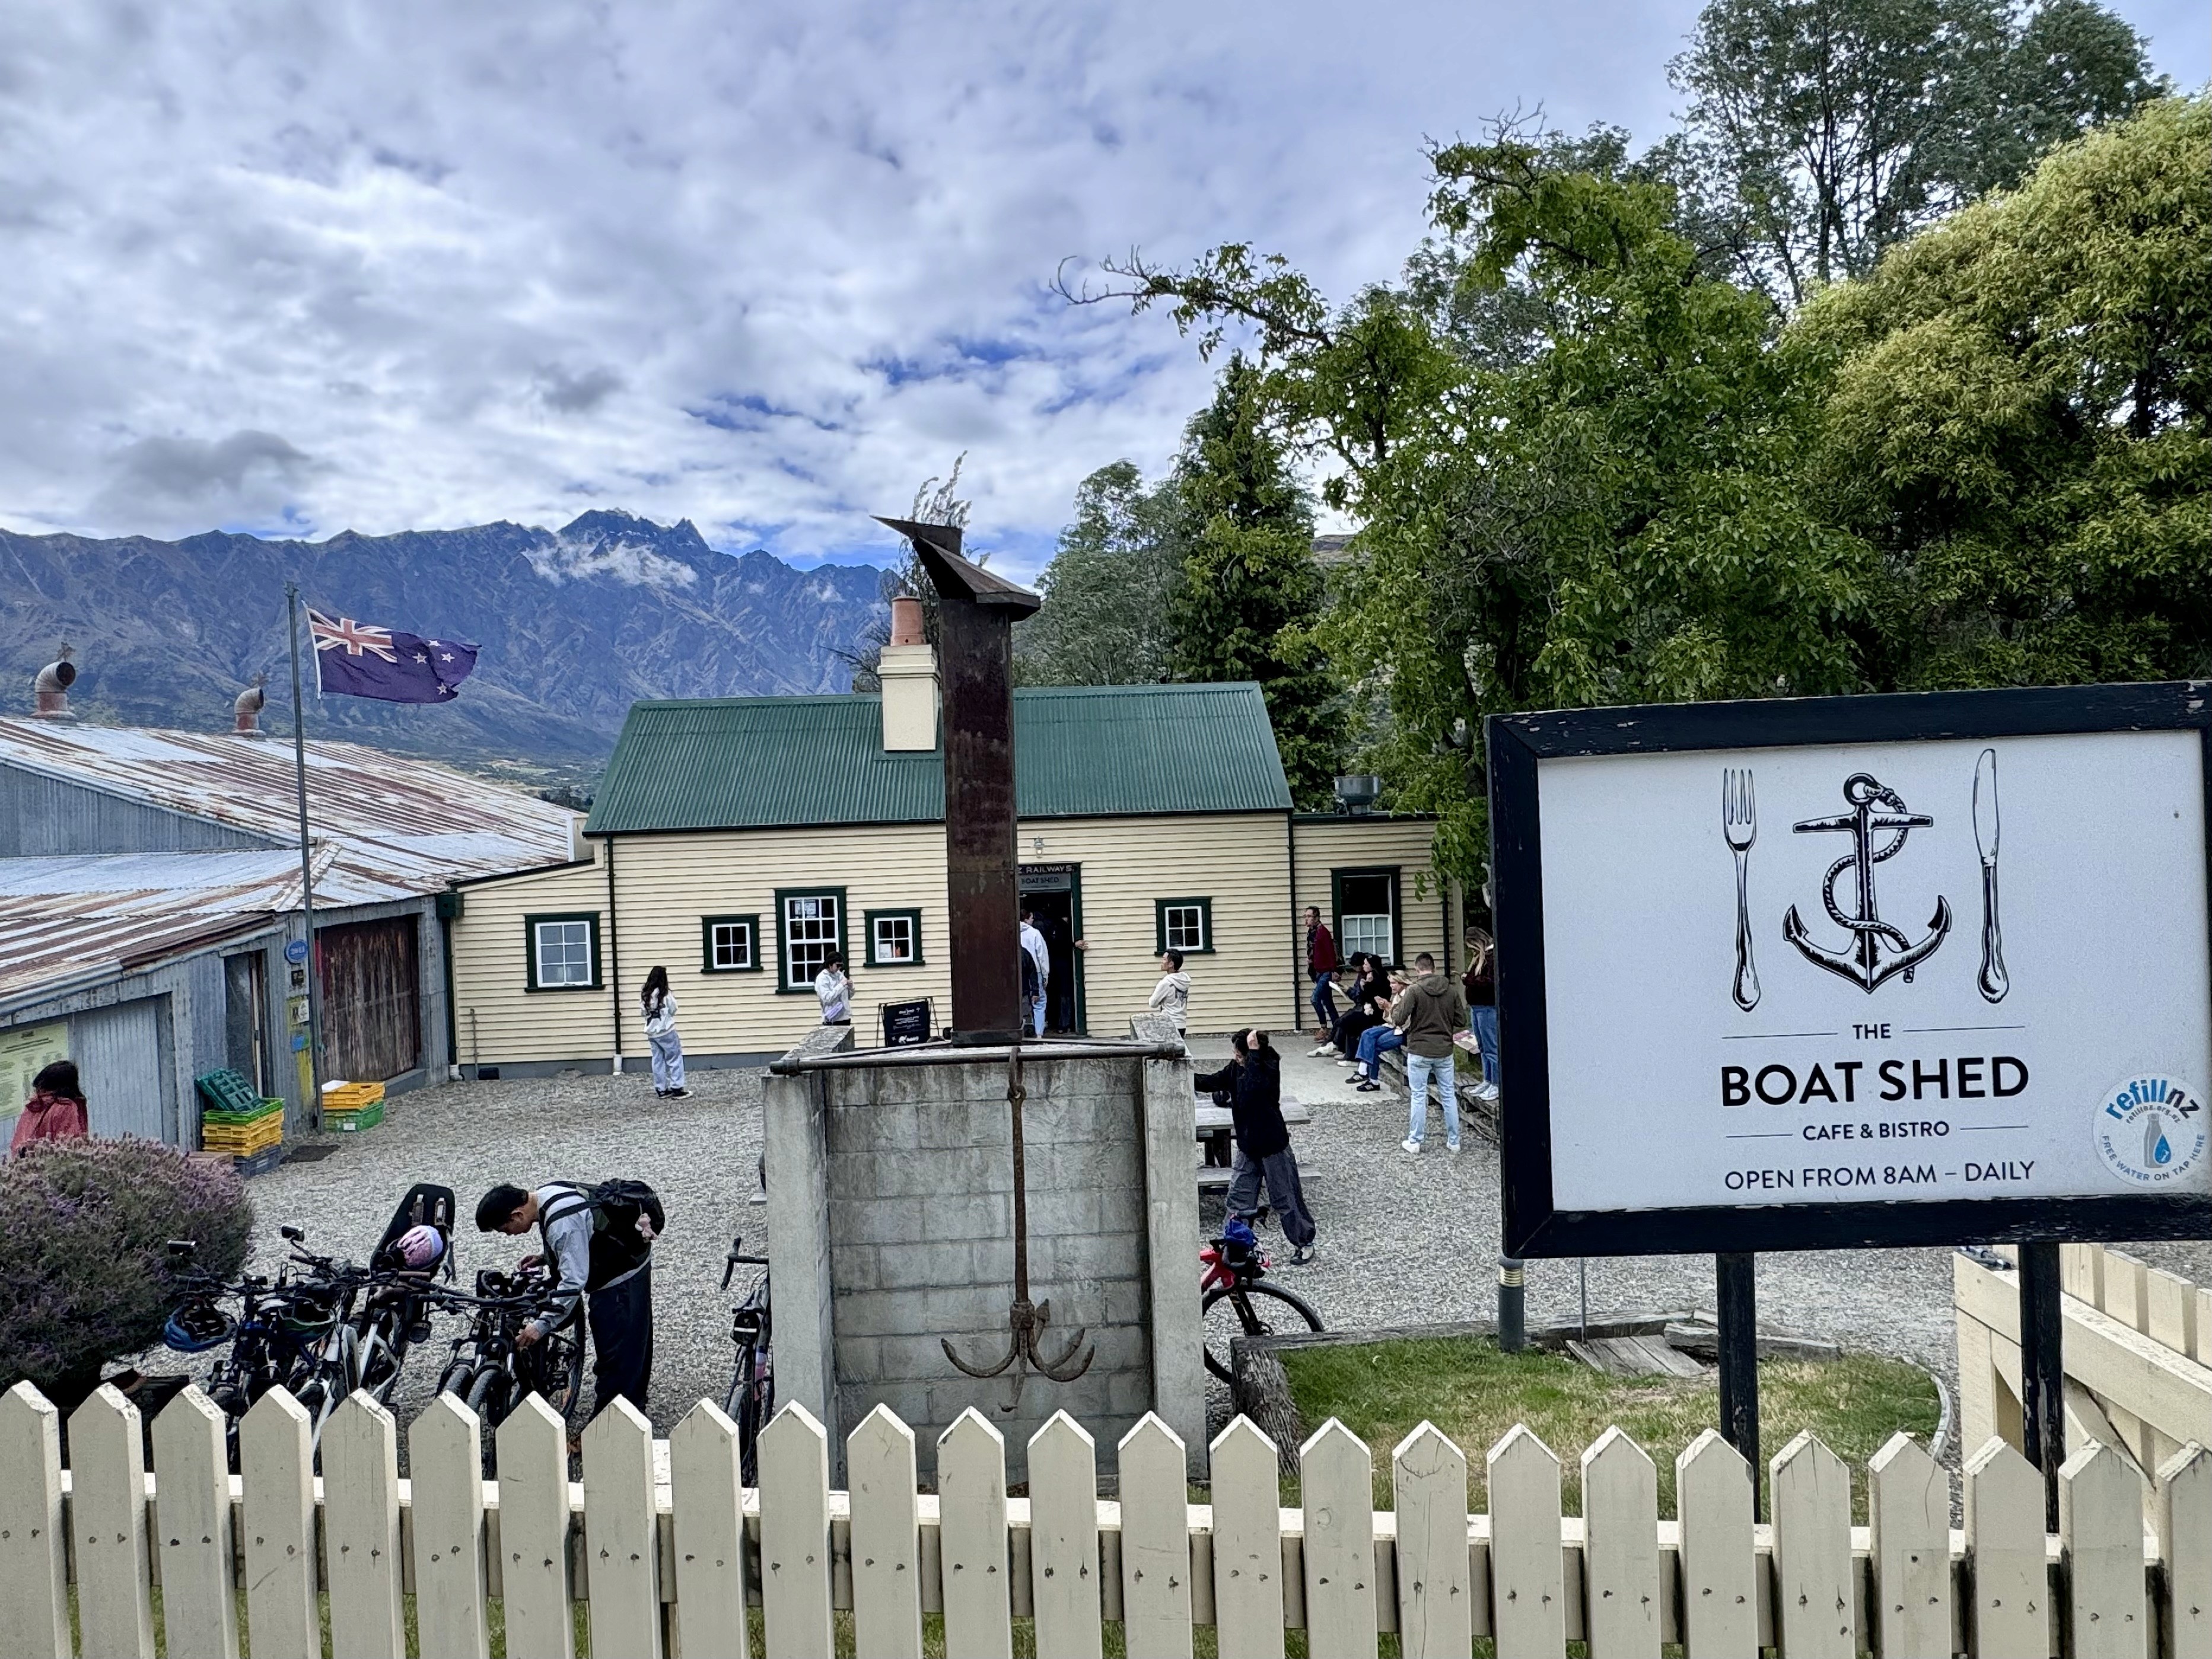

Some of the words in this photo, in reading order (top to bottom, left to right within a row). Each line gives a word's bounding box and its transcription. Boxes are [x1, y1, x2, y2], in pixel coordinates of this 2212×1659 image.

[1853, 1023, 1892, 1040] THE
[1721, 1062, 1863, 1107] BOAT
[1879, 1056, 2029, 1101] SHED
[2106, 1079, 2200, 1120] refillnz
[2125, 1105, 2181, 1124] refillnz.org.nz
[1802, 1125, 1854, 1141] CAFE
[1860, 1123, 1874, 1139] &
[1879, 1120, 1950, 1138] BISTRO
[2102, 1135, 2117, 1161] FREE
[2116, 1160, 2150, 1181] WATER
[2154, 1172, 2170, 1181] ON
[2172, 1161, 2190, 1176] TAP
[2189, 1133, 2205, 1161] HERE
[1725, 1169, 1794, 1190] OPEN
[1803, 1166, 1876, 1187] FROM
[1883, 1164, 1937, 1184] 8AM
[1965, 1161, 2035, 1182] DAILY
